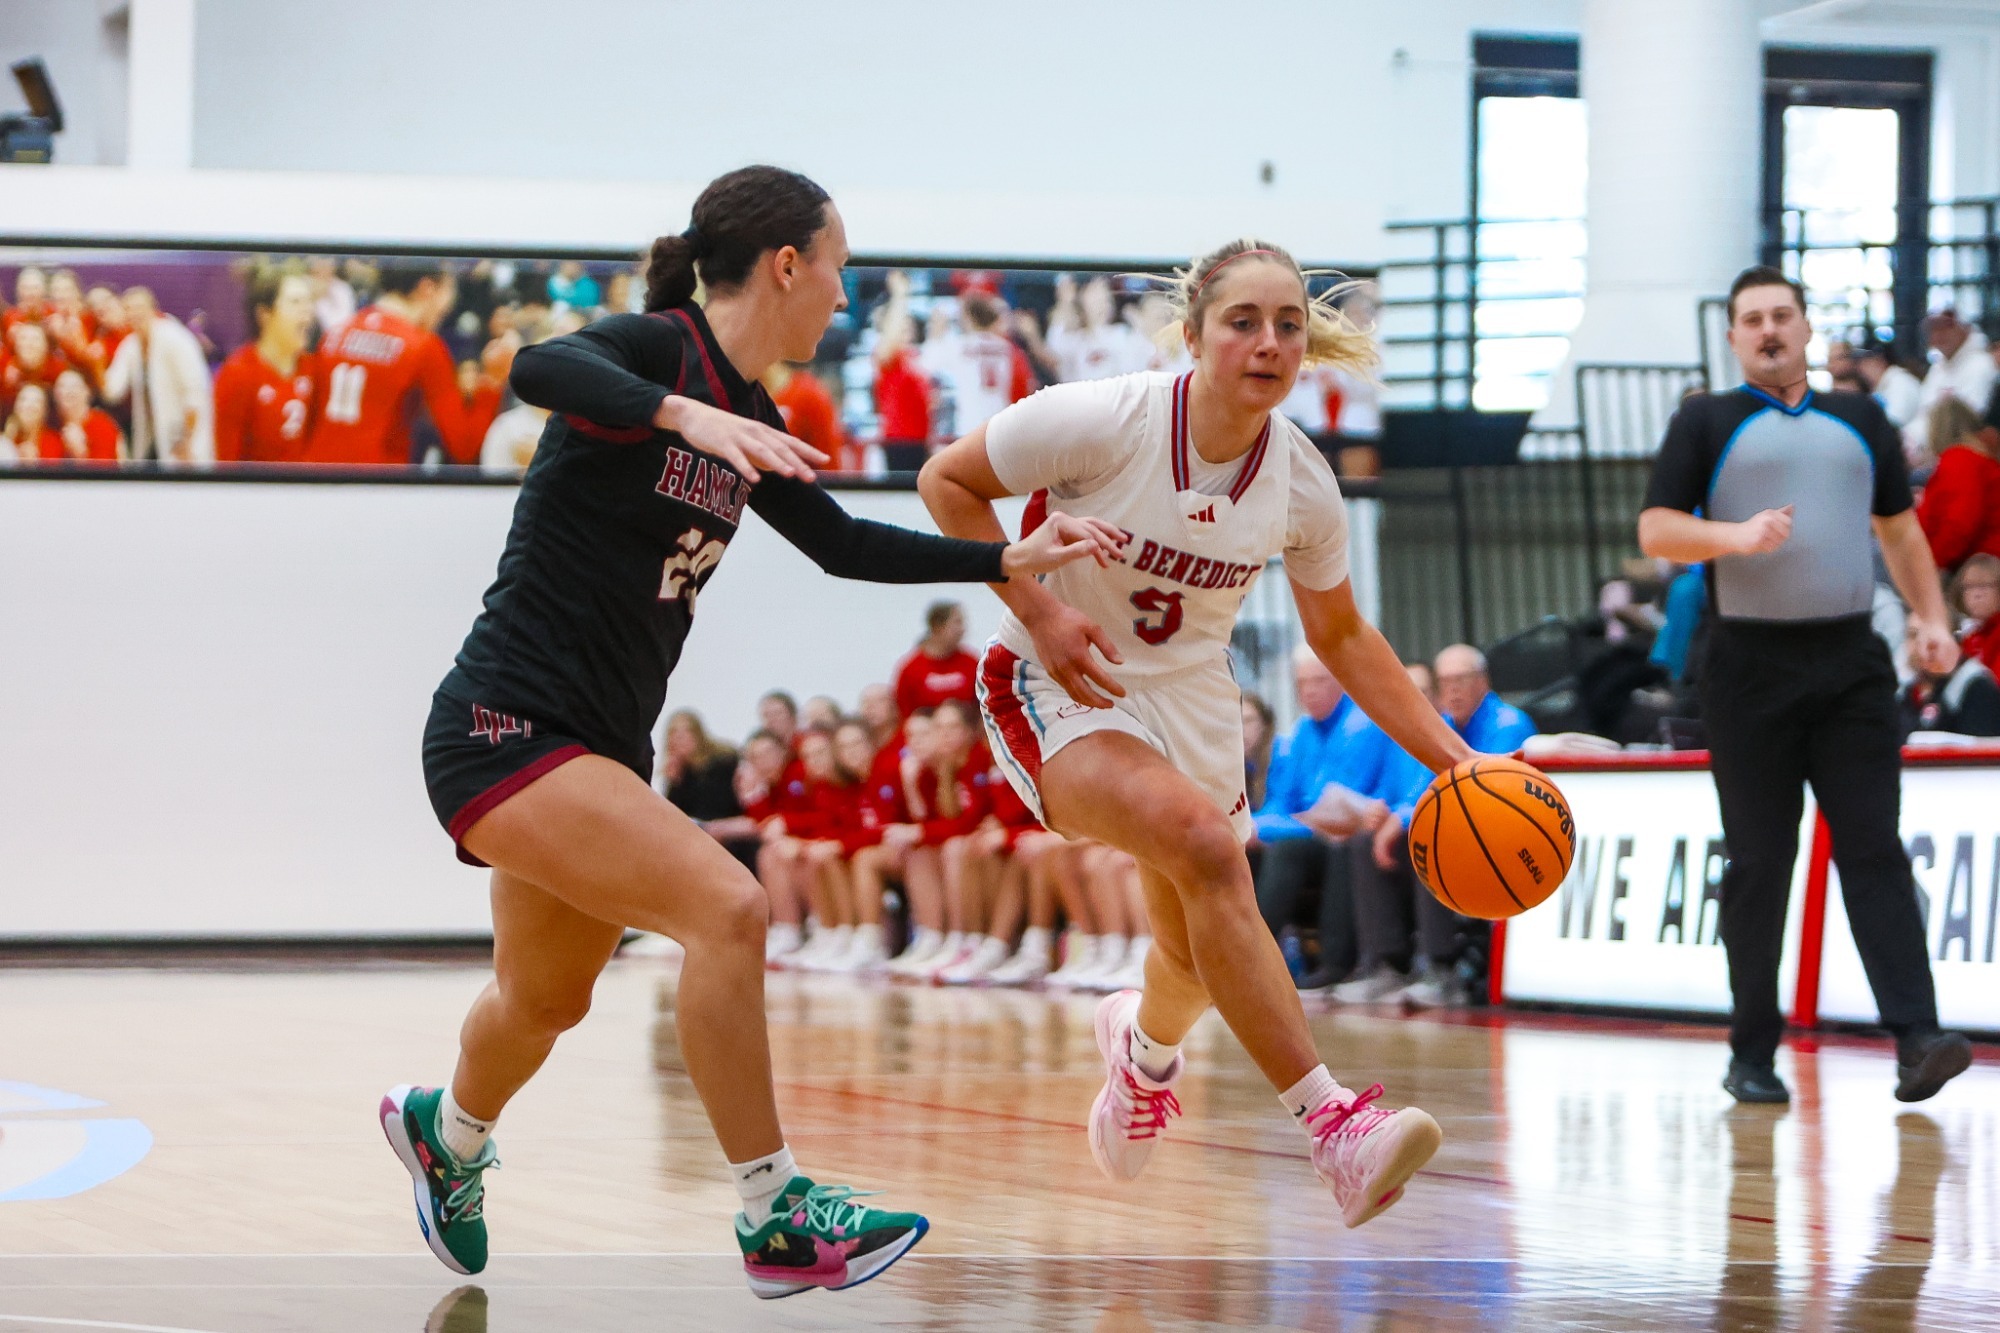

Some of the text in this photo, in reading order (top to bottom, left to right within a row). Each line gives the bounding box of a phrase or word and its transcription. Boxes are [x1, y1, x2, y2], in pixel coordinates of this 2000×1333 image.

[1133, 538, 1262, 590] BENEDICT
[1559, 836, 1634, 941] WE
[1657, 837, 1729, 945] AR
